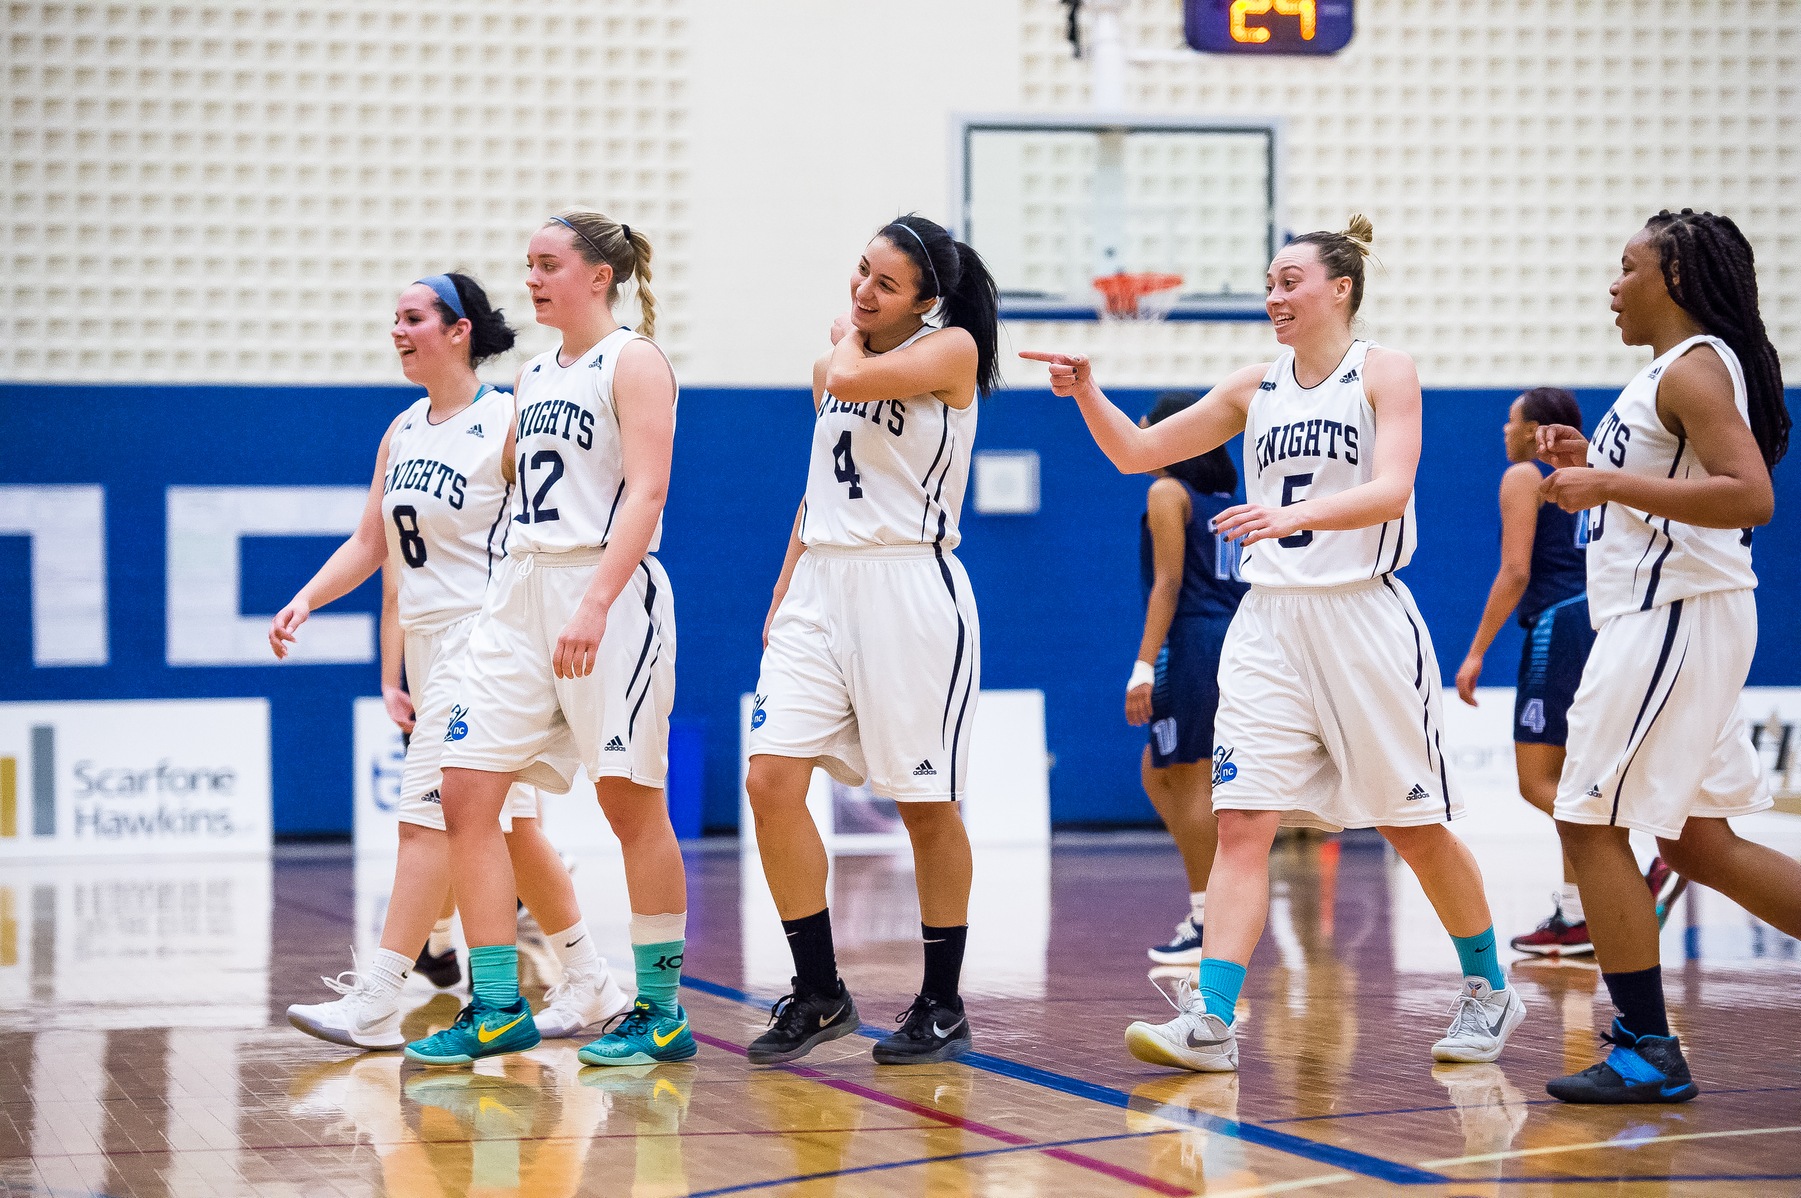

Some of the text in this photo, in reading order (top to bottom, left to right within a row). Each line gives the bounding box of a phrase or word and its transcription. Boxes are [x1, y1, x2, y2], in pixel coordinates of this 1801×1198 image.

[516, 400, 595, 451] NIGHTS
[833, 430, 863, 499] 4
[513, 450, 565, 525] 12
[1278, 473, 1314, 548] 5
[392, 505, 427, 568] 8
[453, 726, 465, 735] nc
[1520, 698, 1546, 733] 4
[73, 757, 236, 799] Scarfone
[912, 768, 937, 776] adidas
[1222, 767, 1234, 777] nc
[1406, 793, 1430, 801] adidas
[74, 802, 234, 841] Hawkins
